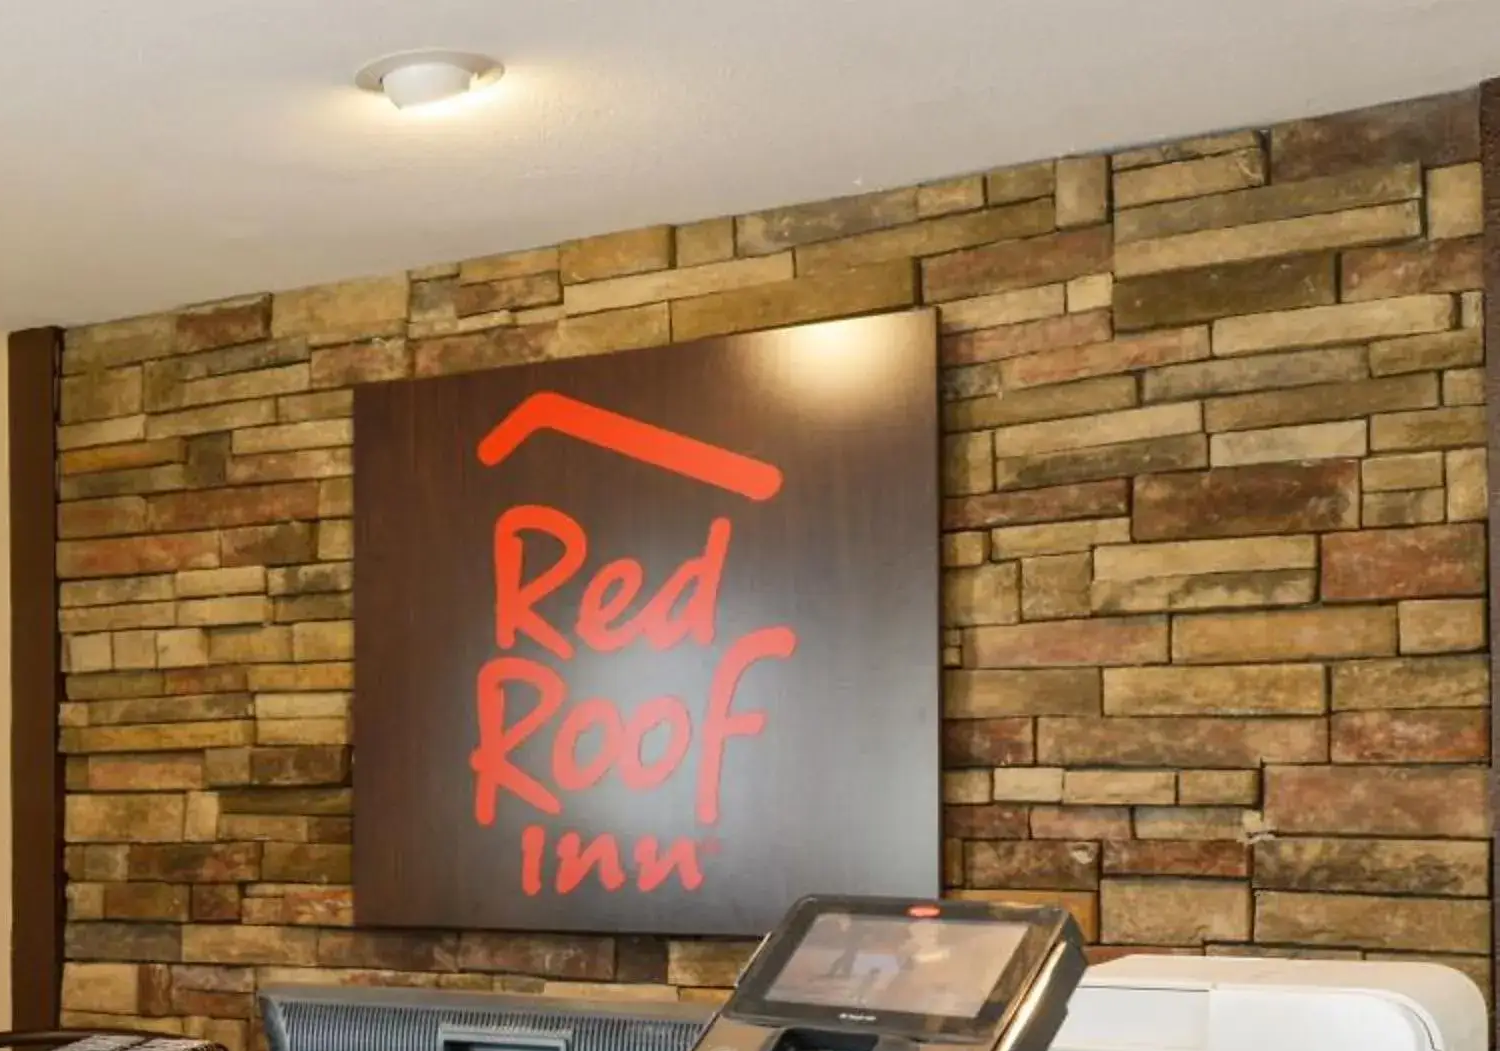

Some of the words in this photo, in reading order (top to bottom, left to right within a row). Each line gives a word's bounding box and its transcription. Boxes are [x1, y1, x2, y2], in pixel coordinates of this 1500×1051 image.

[493, 504, 731, 660] Red
[470, 625, 797, 826] Roof
[521, 825, 703, 897] Inn
